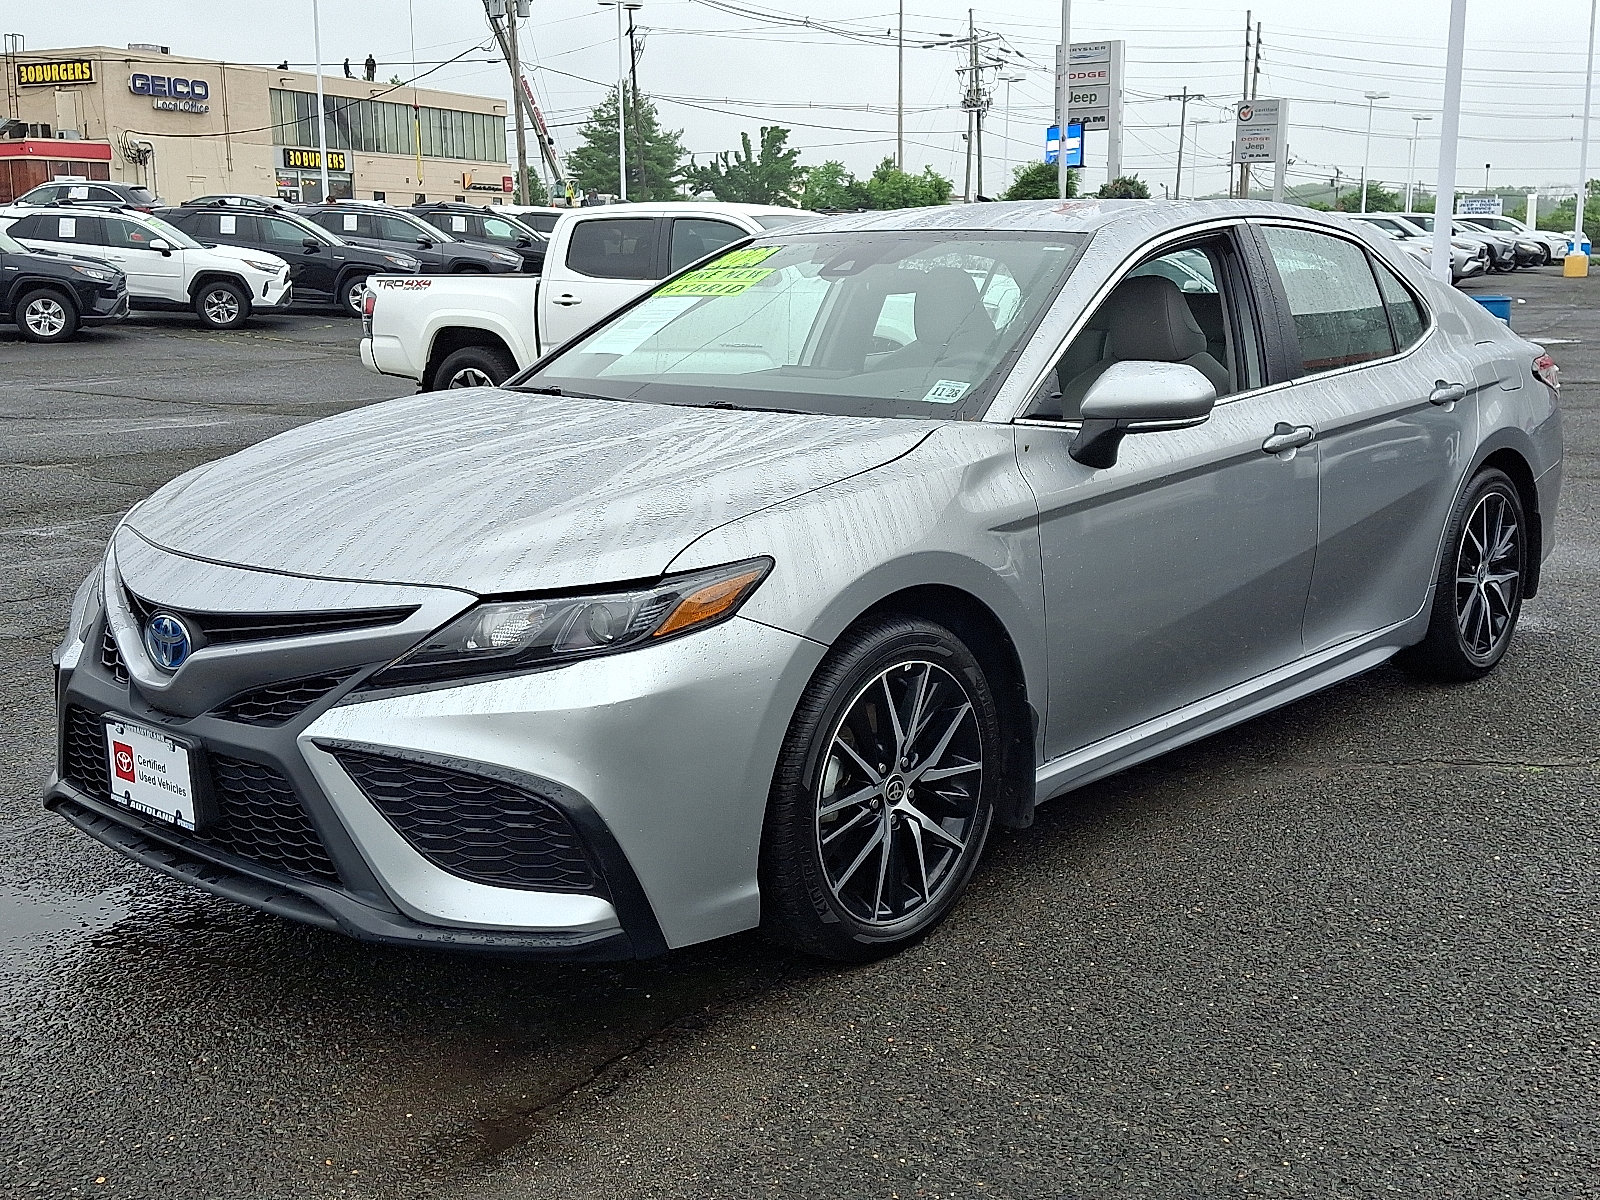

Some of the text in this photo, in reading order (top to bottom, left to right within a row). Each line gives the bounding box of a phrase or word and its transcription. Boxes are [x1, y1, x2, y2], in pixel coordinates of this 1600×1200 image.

[1058, 71, 1107, 80] ODGE
[131, 73, 209, 99] GEICO
[1068, 91, 1097, 104] Jeep
[156, 99, 210, 113] Local Office
[1245, 142, 1265, 150] Jeep
[303, 151, 345, 169] BURERS
[376, 279, 405, 290] TRD
[932, 387, 947, 397] 11
[137, 754, 167, 774] Certified
[138, 770, 188, 797] Used Vehicles
[129, 800, 175, 824] AUTOLAND
